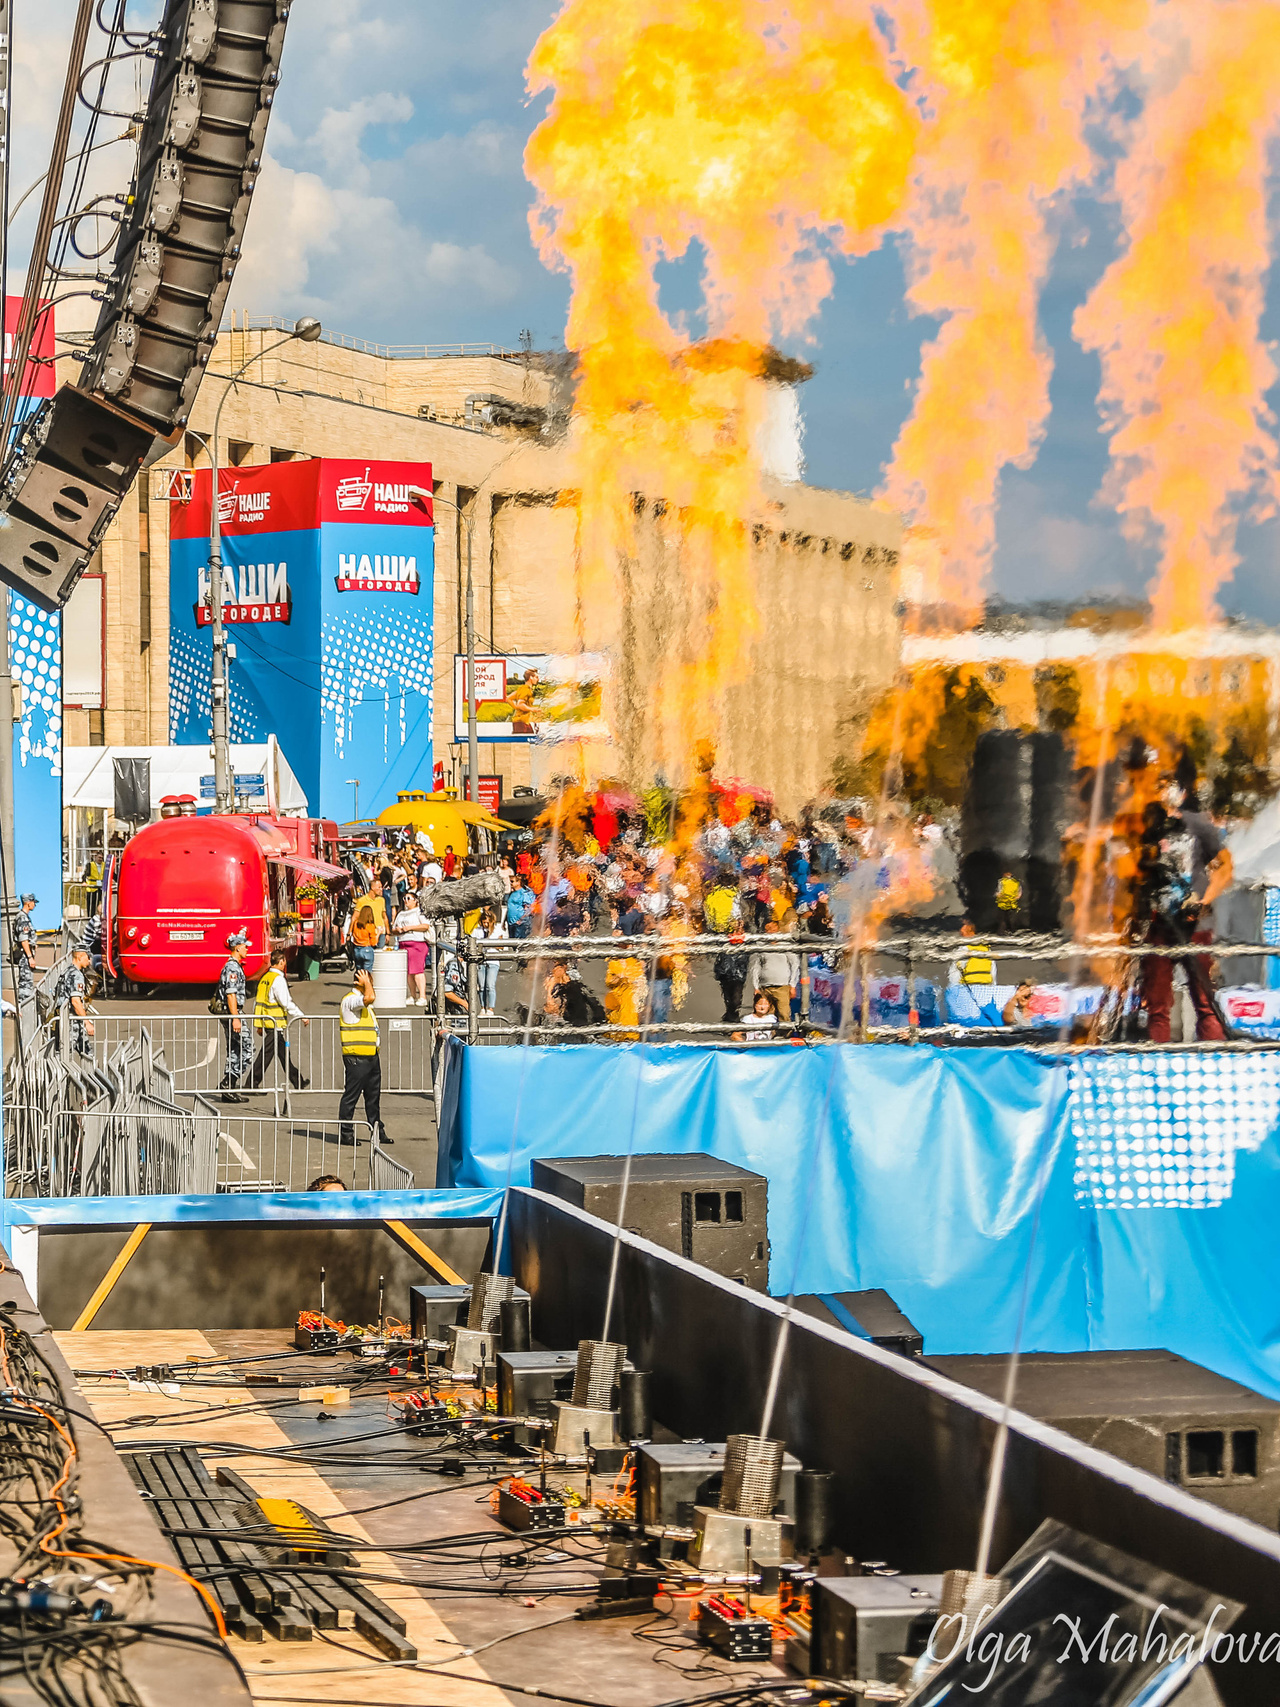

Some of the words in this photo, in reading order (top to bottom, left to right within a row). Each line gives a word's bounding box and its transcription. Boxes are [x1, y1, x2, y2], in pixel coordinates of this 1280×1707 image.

[239, 492, 271, 512] НАШЕ
[374, 502, 409, 513] РАДИО
[239, 512, 264, 523] РАДИО
[339, 554, 417, 582] НАШИ
[344, 580, 351, 589] В
[359, 581, 411, 592] ГОРОДЕ
[221, 606, 281, 621] ГОРОДЕ
